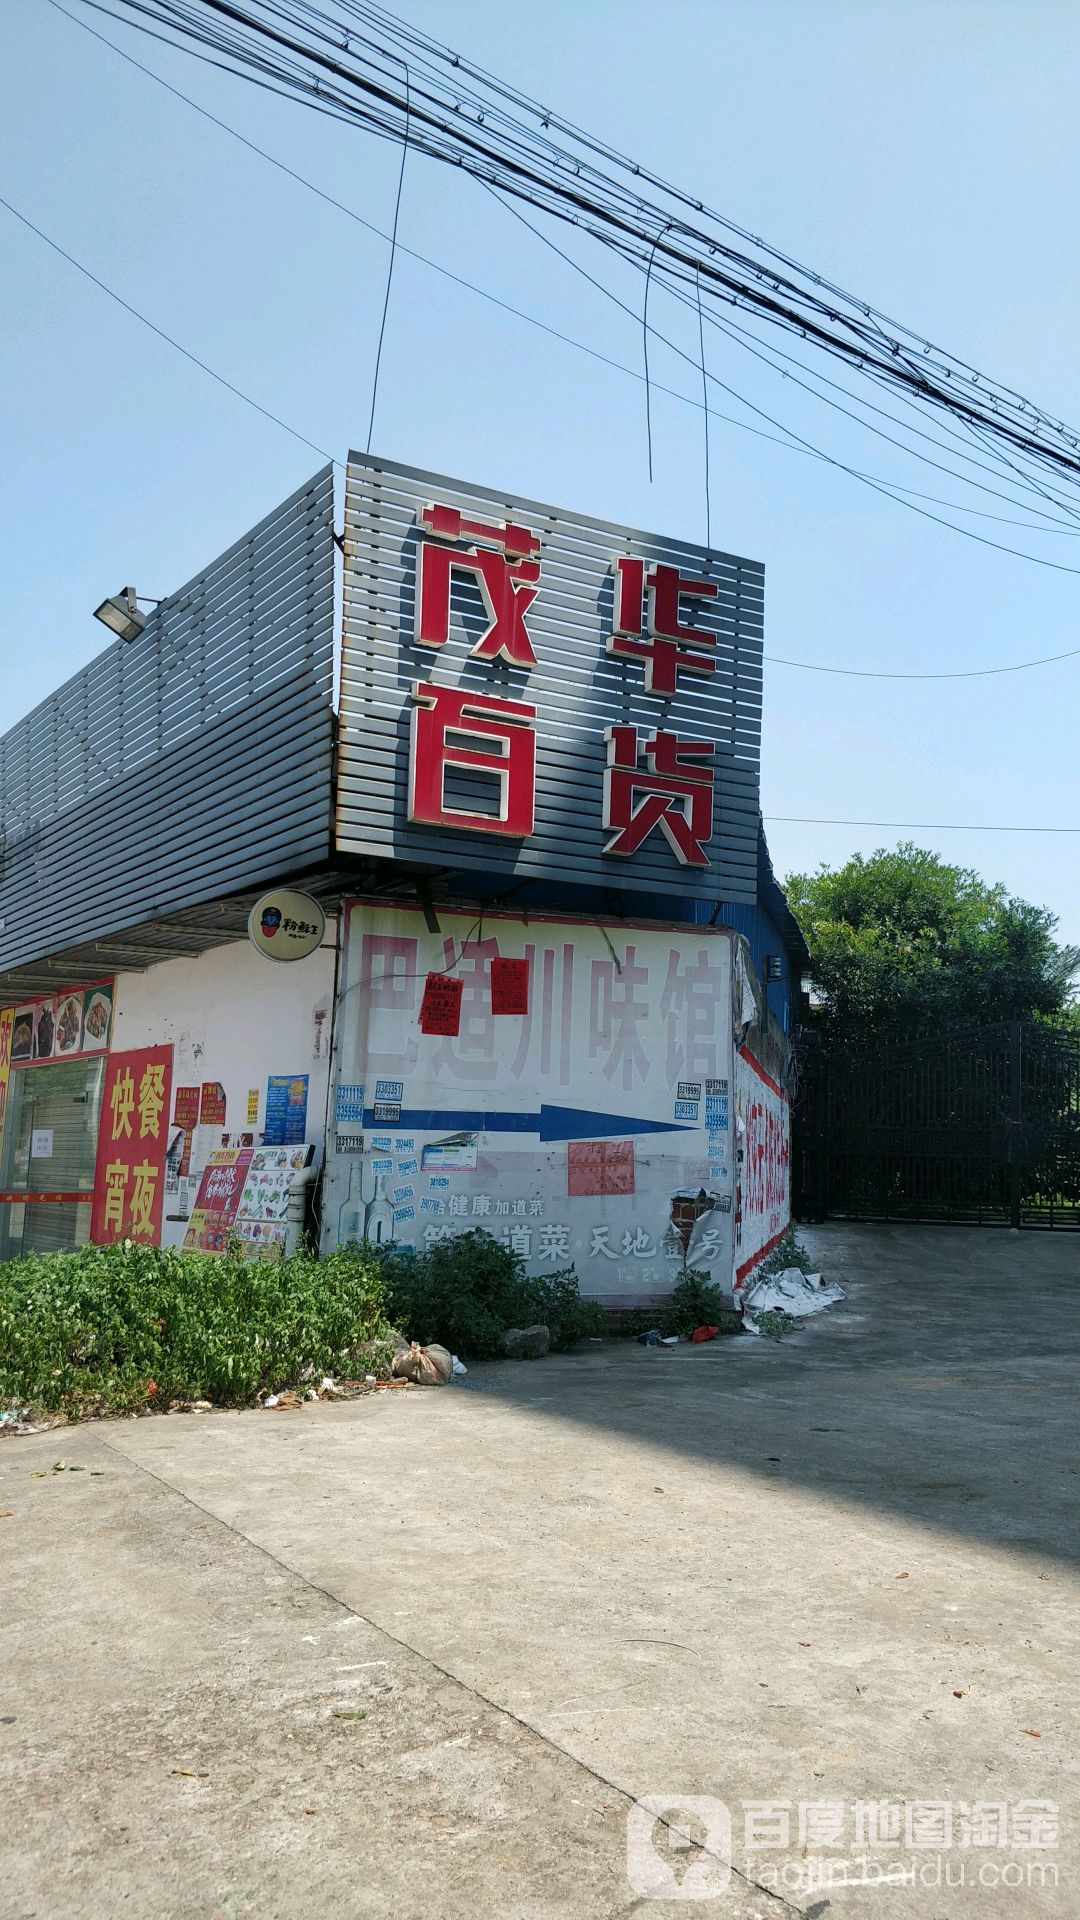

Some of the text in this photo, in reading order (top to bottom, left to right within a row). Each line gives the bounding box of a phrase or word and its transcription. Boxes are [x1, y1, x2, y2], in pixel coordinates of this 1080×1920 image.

[416, 502, 719, 697] 茂华
[407, 681, 715, 868] 百货
[355, 934, 722, 1091] 巴适川味馆
[110, 1064, 166, 1141] 快餐
[378, 1083, 401, 1095] 3303351
[104, 1158, 159, 1237] 宵夜
